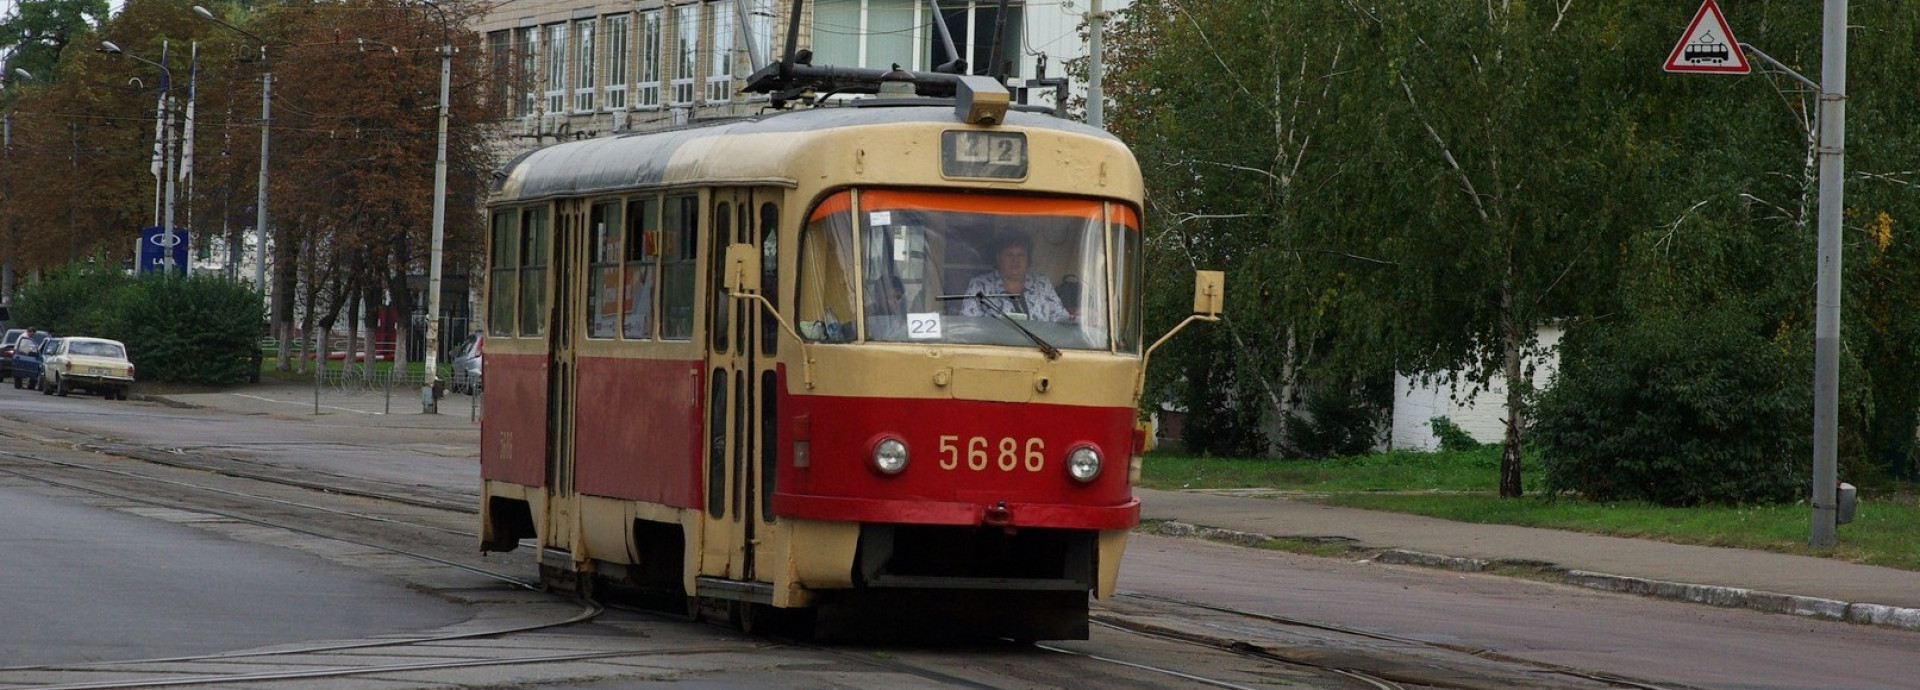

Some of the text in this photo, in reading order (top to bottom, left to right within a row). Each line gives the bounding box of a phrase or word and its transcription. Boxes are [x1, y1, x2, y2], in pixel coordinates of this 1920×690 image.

[152, 257, 177, 266] LAA
[911, 319, 937, 334] 22
[939, 435, 1046, 472] 5686
